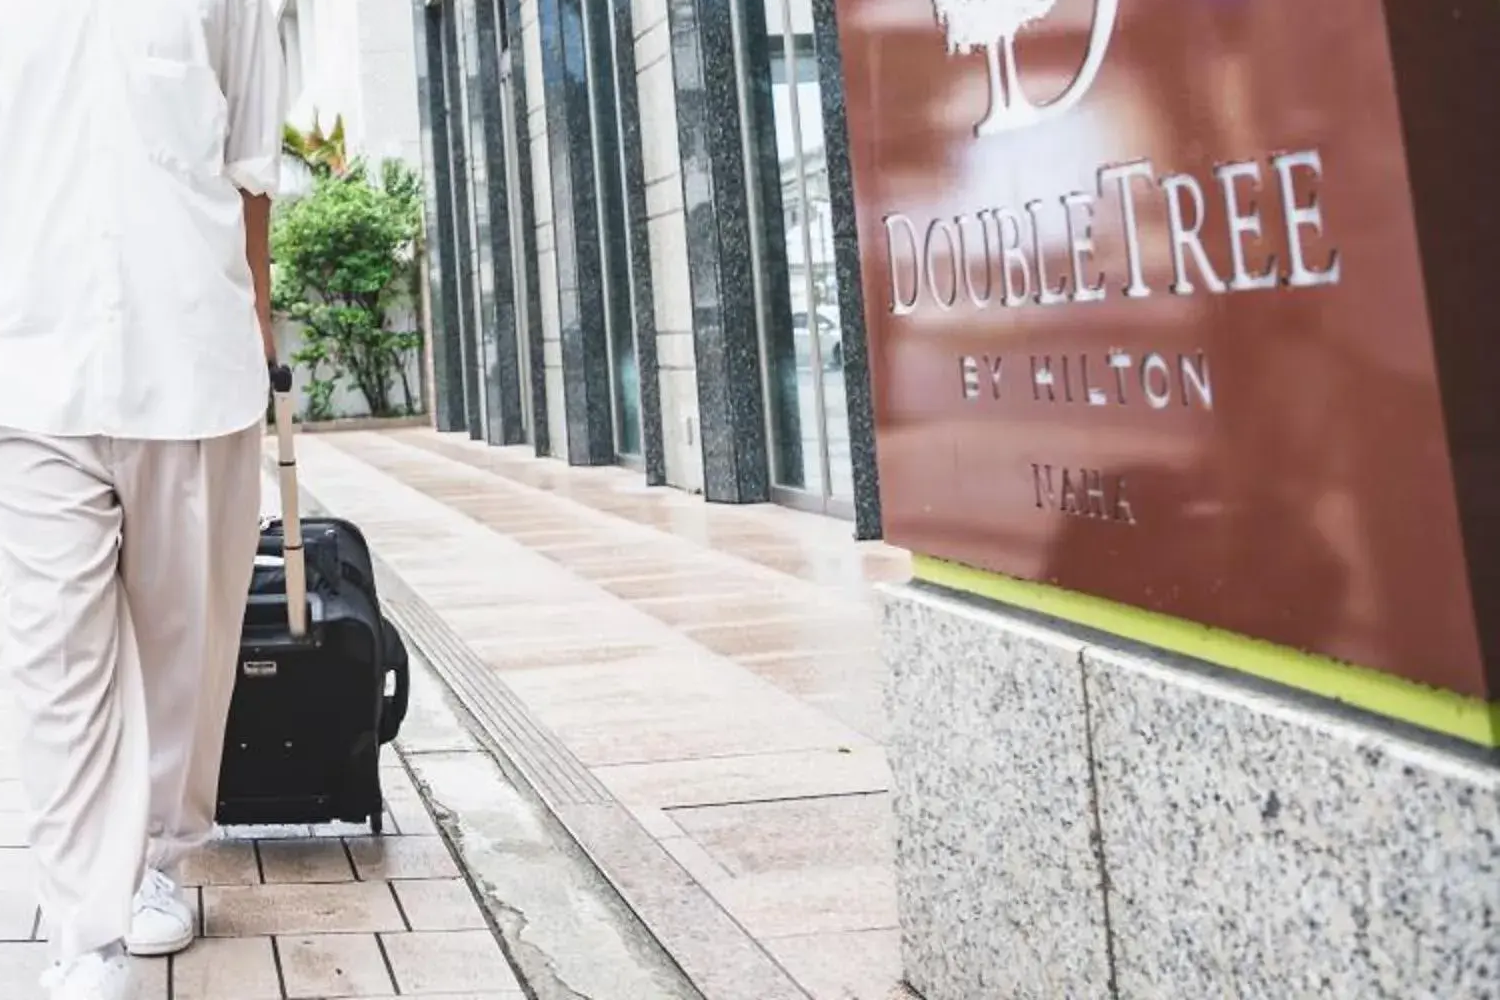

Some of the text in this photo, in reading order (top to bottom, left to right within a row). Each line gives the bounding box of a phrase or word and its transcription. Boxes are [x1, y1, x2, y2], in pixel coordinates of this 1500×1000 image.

[882, 149, 1341, 316] DOUBLETREE
[958, 348, 1213, 411] BY HILTON
[1030, 463, 1137, 526] NAHA
